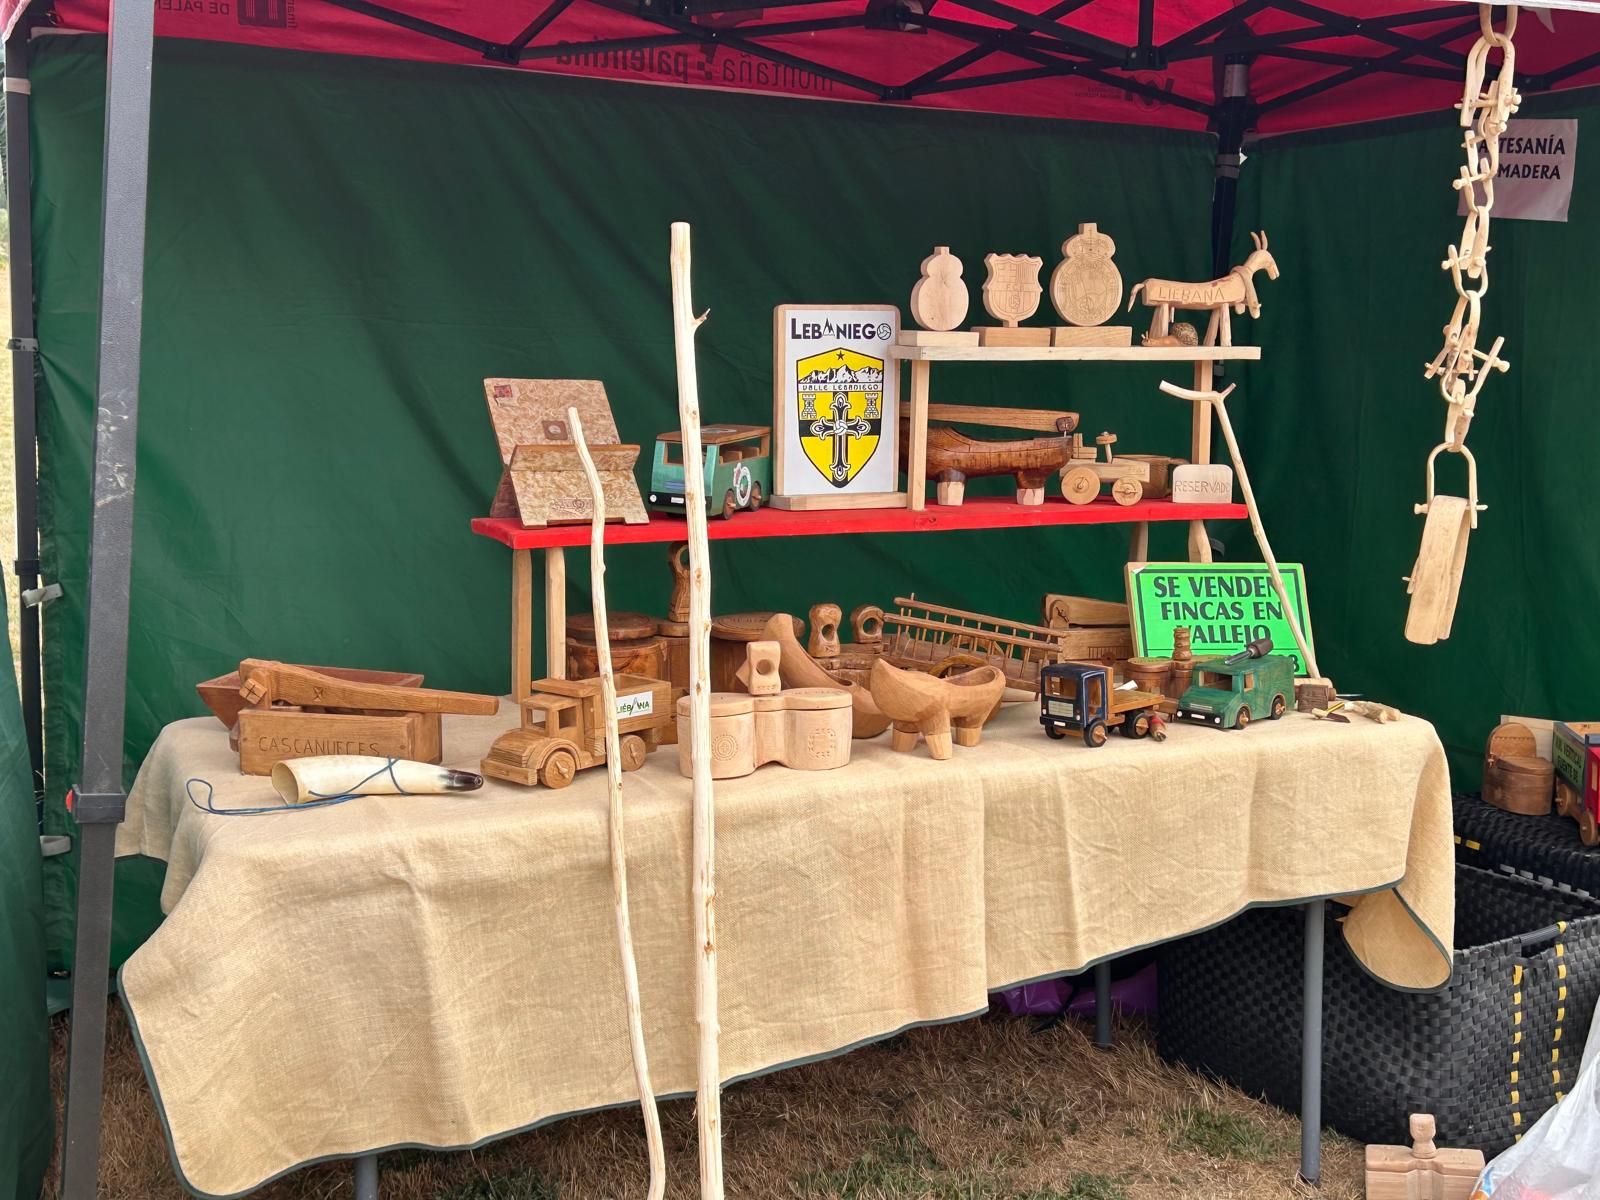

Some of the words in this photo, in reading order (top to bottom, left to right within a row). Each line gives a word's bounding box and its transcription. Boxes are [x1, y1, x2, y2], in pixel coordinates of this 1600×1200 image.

[1478, 134, 1566, 155] ATESANÍA
[1497, 163, 1561, 180] MADERA
[1153, 576, 1181, 598] SE
[1161, 601, 1244, 621] FINCAS
[1253, 601, 1283, 621] EN
[1176, 624, 1272, 648] ALLEJO
